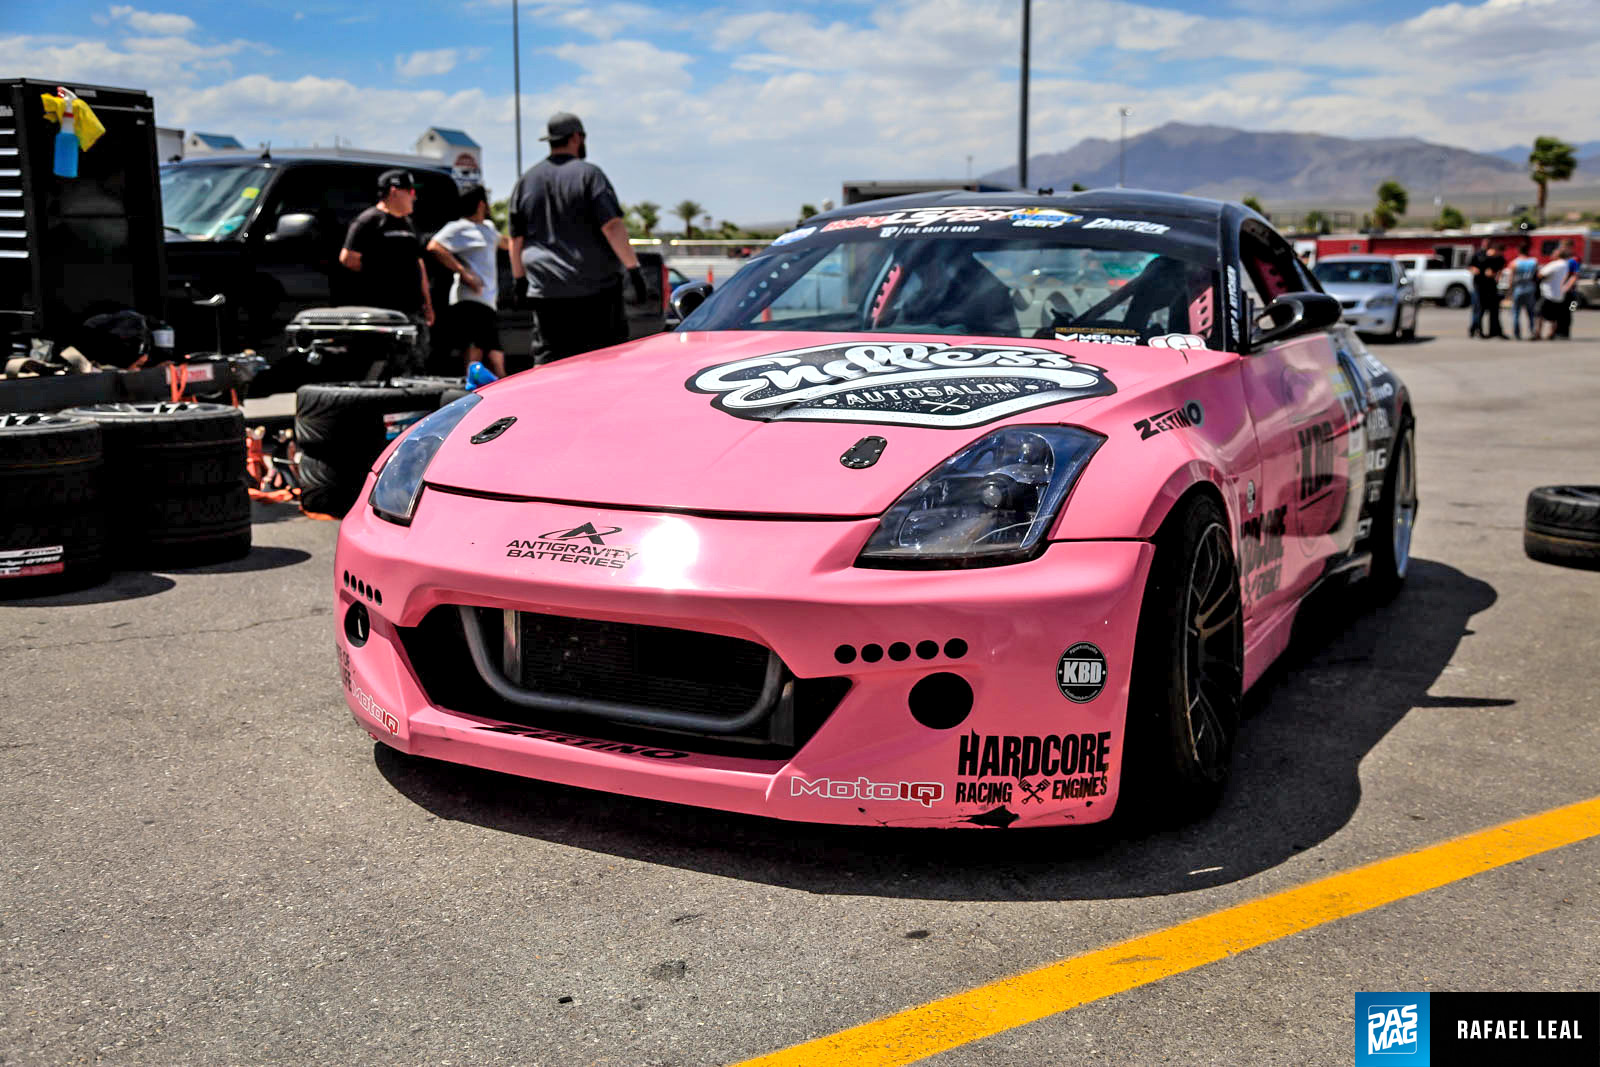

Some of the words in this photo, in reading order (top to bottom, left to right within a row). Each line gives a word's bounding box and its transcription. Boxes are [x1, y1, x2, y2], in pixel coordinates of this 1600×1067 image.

[903, 227, 918, 235] THE
[950, 225, 980, 233] GROUP
[1079, 333, 1137, 344] MEGAN
[696, 342, 1098, 408] Endless
[846, 382, 1018, 405] AUTOSALON
[1133, 402, 1203, 441] ZESTINO
[506, 539, 639, 560] ANTIGRAVITY
[506, 549, 626, 569] BATTERIES
[1063, 661, 1102, 683] KBD
[351, 679, 400, 735] MotoIQ
[471, 724, 690, 759] ZESTINO
[958, 729, 1111, 779] HARDCORE
[791, 776, 945, 808] MotoIQ
[955, 782, 1013, 805] RACING
[1052, 776, 1109, 801] ENGINES
